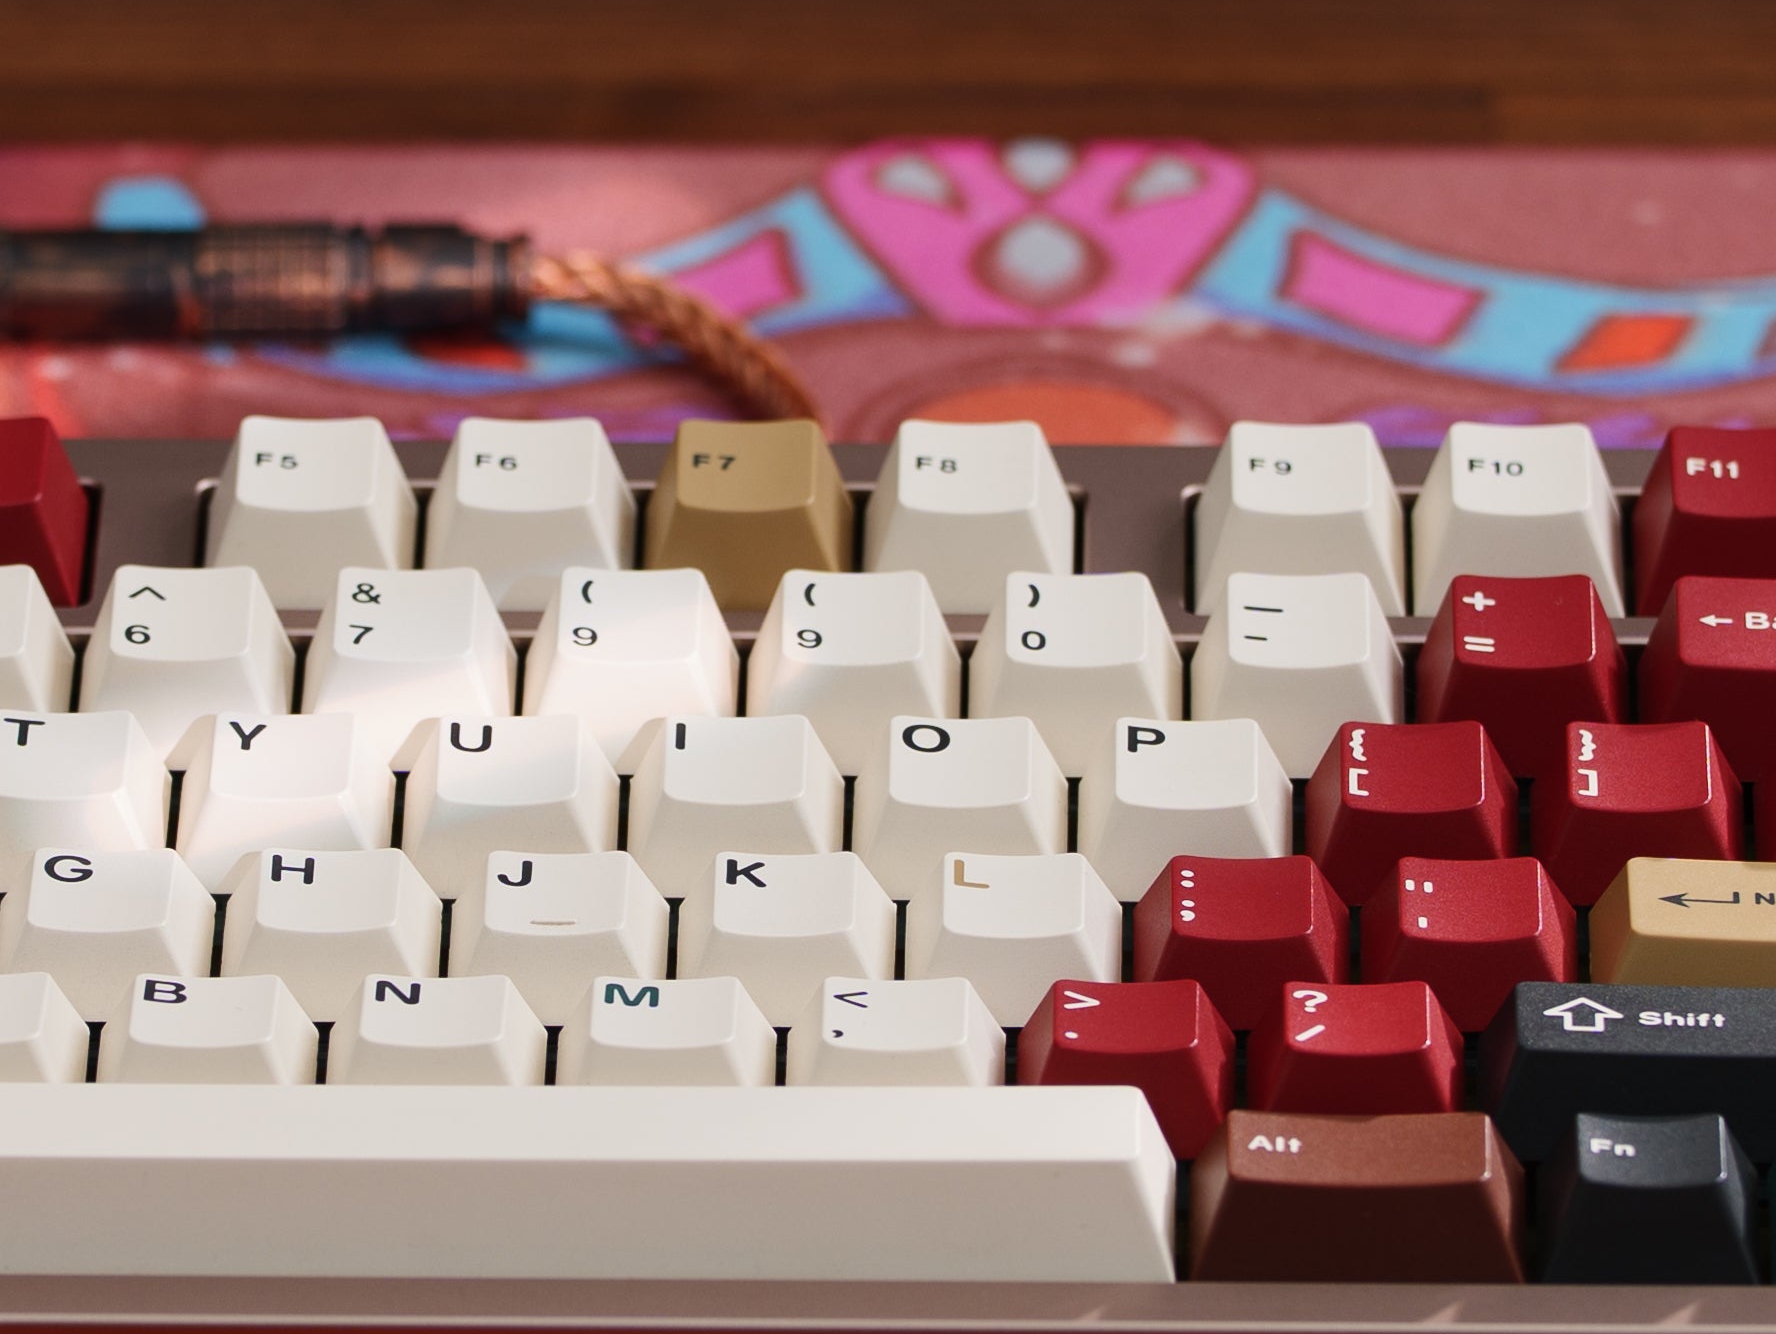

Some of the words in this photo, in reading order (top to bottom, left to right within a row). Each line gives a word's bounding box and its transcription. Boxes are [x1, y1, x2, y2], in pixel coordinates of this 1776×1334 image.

[256, 453, 297, 468] F5
[476, 455, 516, 469] F6
[693, 454, 735, 470] F7
[916, 457, 956, 472] F8
[1250, 459, 1291, 473] F9
[1469, 459, 1523, 475] F10
[1687, 458, 1738, 478] F11
[129, 587, 165, 600] ^
[352, 584, 380, 604] &
[582, 581, 593, 603] (
[805, 584, 815, 606] (
[1029, 585, 1040, 607] )
[1463, 592, 1495, 611] +
[125, 625, 150, 644] 6
[350, 625, 373, 644] 7
[573, 627, 597, 646] 9
[797, 630, 822, 648] 9
[1022, 631, 1046, 650] 0
[1464, 636, 1495, 652] =
[4, 718, 45, 746] T
[230, 722, 266, 750] Y
[451, 723, 492, 752] U
[676, 723, 686, 750] I
[902, 725, 950, 752] O
[1128, 726, 1165, 752] P
[1349, 768, 1369, 796] [
[1578, 769, 1598, 796] ]
[44, 856, 93, 882] G
[271, 855, 314, 884] H
[498, 861, 532, 886] J
[726, 859, 766, 887] K
[954, 860, 990, 889] L
[1181, 870, 1194, 887] :
[1180, 900, 1195, 921] ;
[144, 980, 187, 1003] B
[375, 981, 421, 1004] N
[605, 984, 659, 1007] M
[834, 992, 868, 1008] <
[1064, 991, 1100, 1009] >
[1293, 990, 1327, 1012] ?
[1639, 1011, 1725, 1027] Shift
[833, 1030, 843, 1038] ,
[1295, 1025, 1325, 1041] /
[1248, 1135, 1301, 1153] Alt
[1591, 1138, 1635, 1156] Fn
